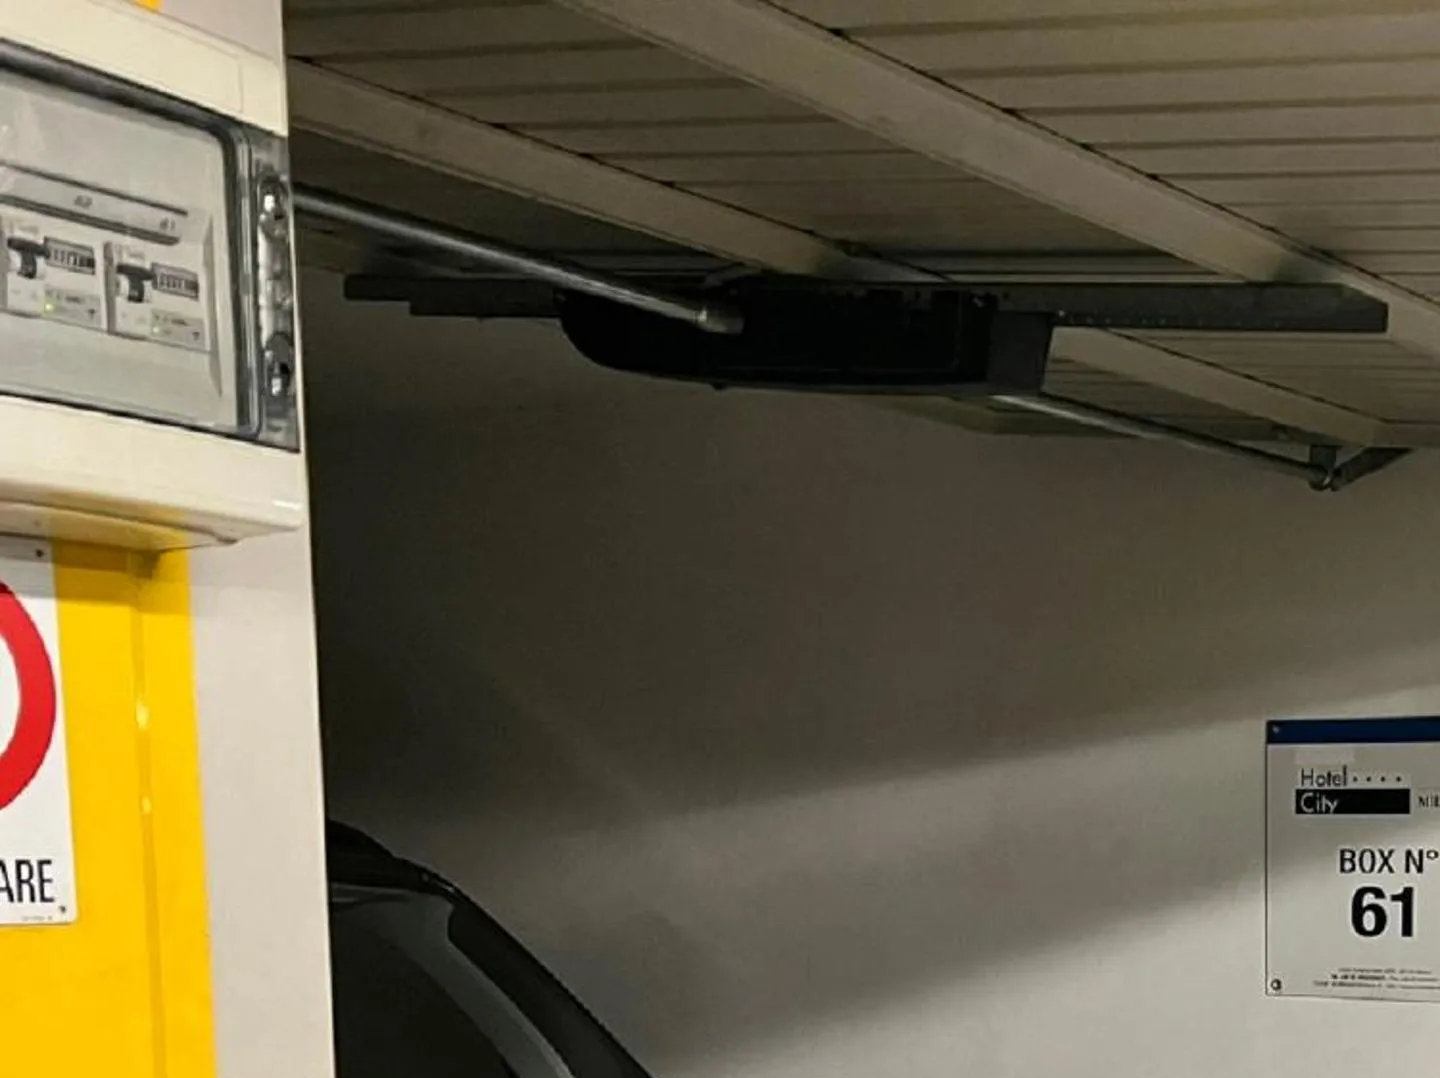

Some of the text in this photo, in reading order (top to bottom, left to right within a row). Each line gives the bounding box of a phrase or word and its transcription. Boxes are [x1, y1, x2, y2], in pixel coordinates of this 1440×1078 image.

[1301, 765, 1347, 787] Hotel
[1301, 793, 1338, 814] City
[1339, 849, 1395, 874] BOX
[1351, 886, 1414, 937] 61
